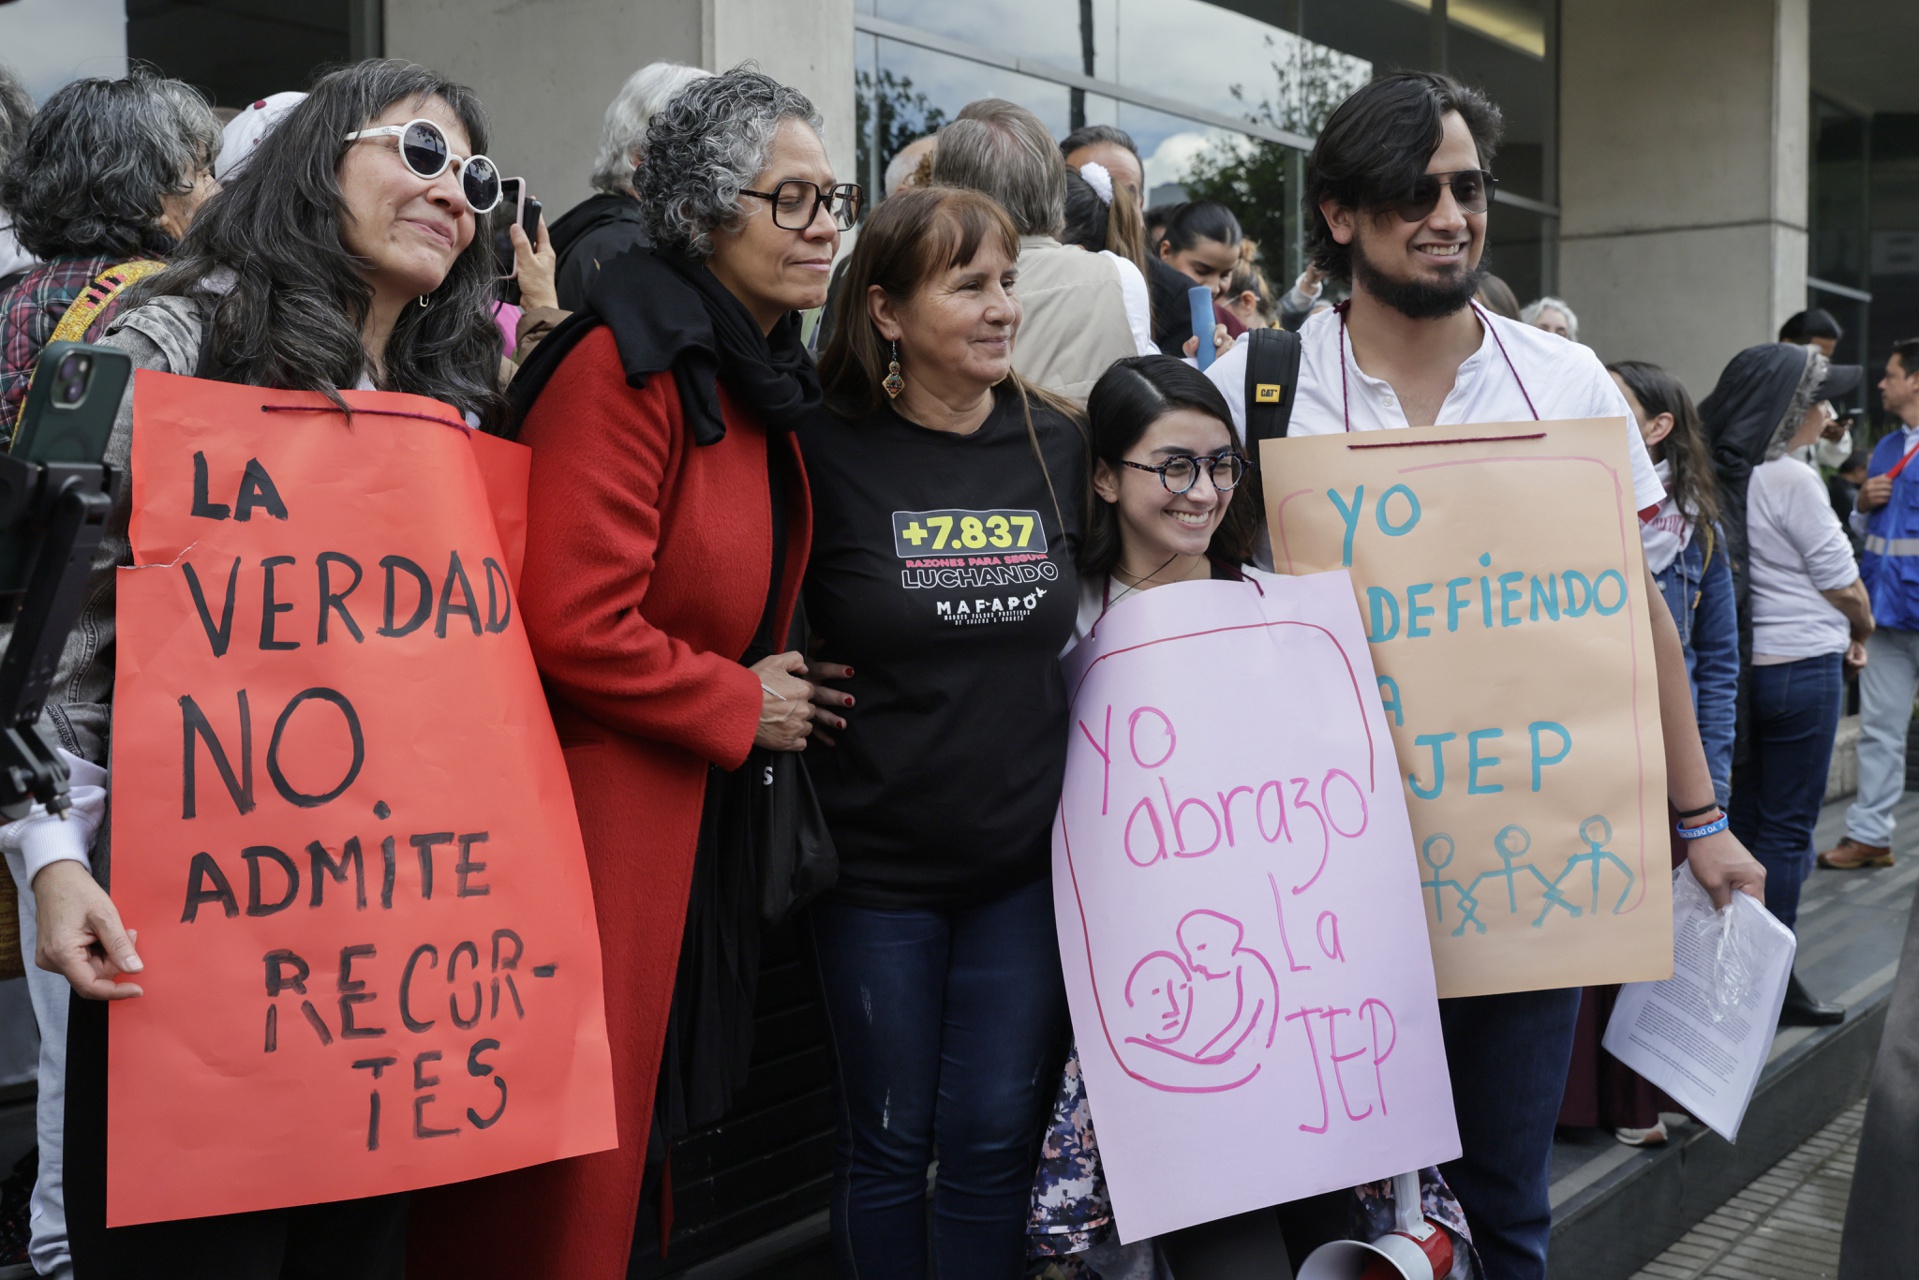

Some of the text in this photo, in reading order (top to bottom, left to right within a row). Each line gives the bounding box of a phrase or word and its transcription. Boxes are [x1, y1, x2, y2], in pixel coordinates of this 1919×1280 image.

[1260, 388, 1275, 398] CAT
[191, 450, 289, 523] LA
[1327, 483, 1422, 567] YO
[902, 515, 1035, 550] +7.837
[905, 558, 965, 569] RAZONES
[968, 557, 1002, 567] PARA
[181, 550, 512, 659] VERDAD
[902, 561, 1059, 589] LUCHANDO
[1376, 675, 1404, 727] A
[1079, 704, 1177, 816] YO
[1409, 721, 1573, 801] JEP
[1124, 769, 1369, 895] abrazo
[1681, 828, 1707, 839] DEFIEN
[264, 929, 558, 1053] RECOR-
[351, 1038, 508, 1151] TES
[1285, 998, 1397, 1134] JEP
